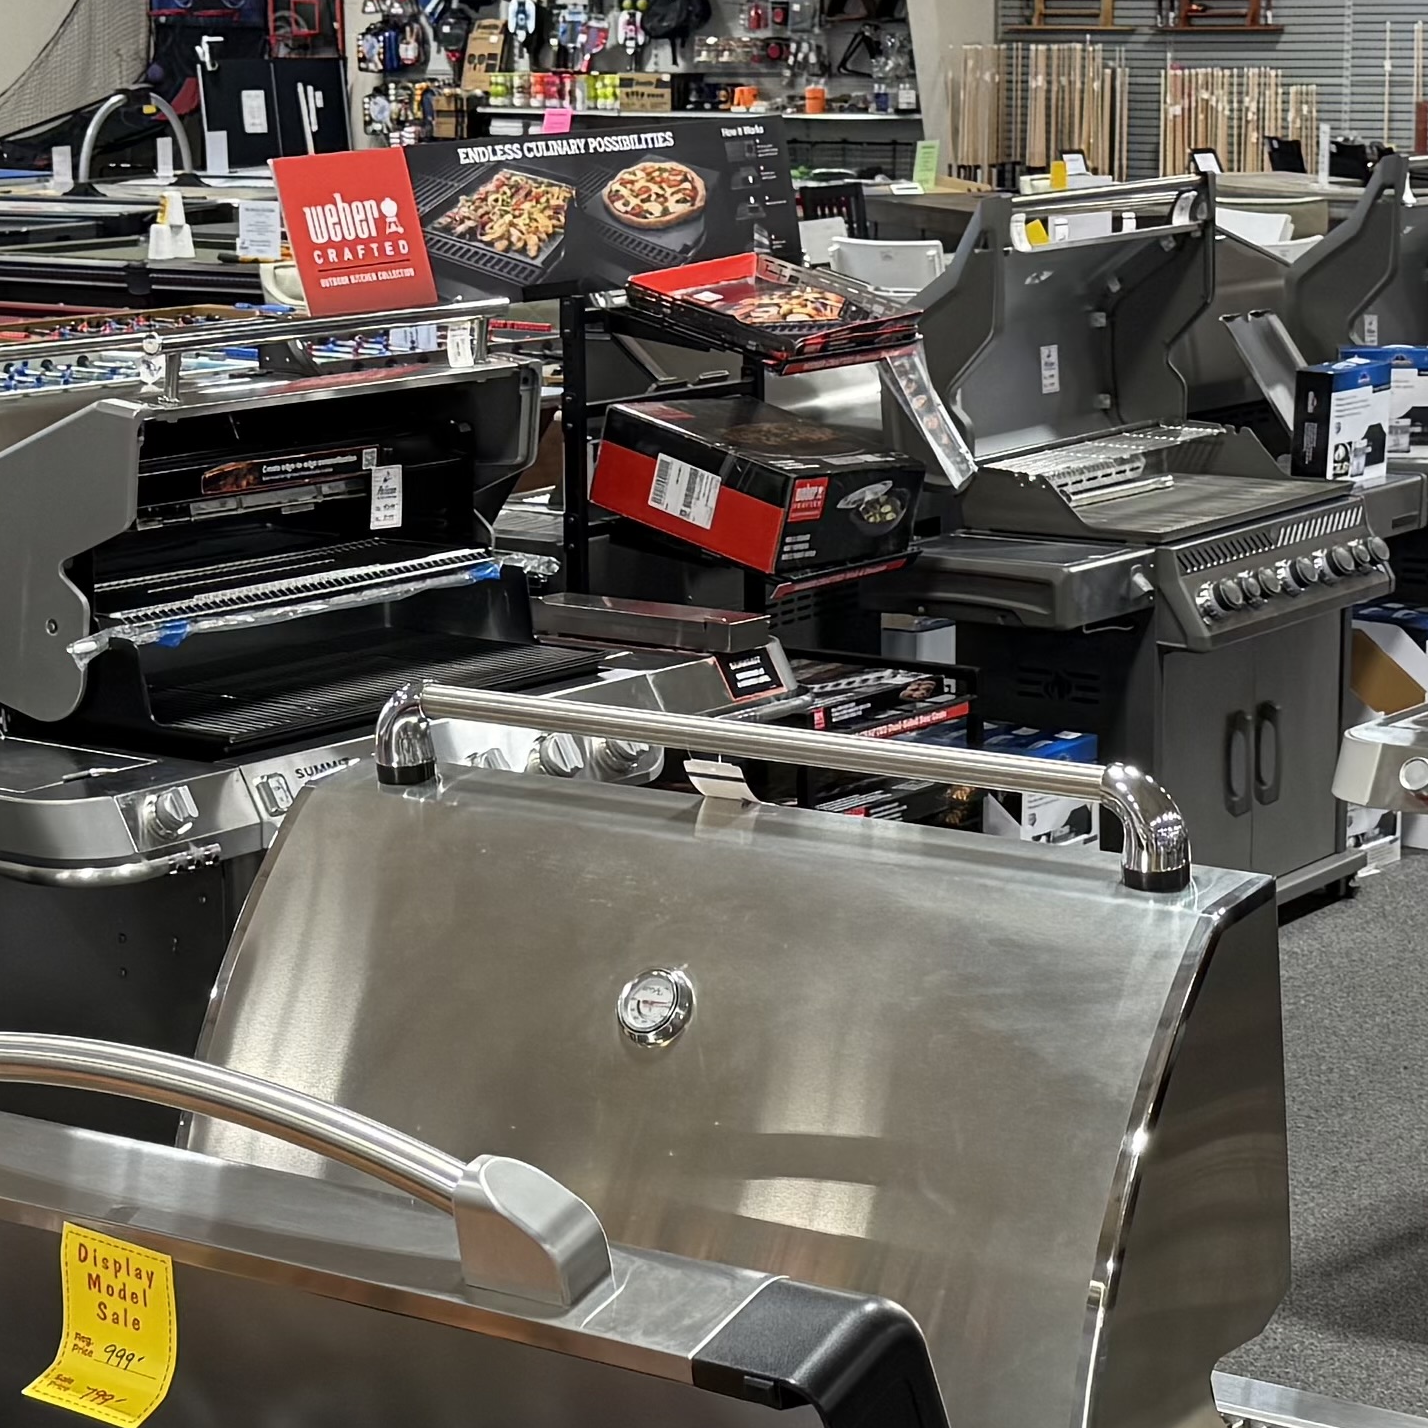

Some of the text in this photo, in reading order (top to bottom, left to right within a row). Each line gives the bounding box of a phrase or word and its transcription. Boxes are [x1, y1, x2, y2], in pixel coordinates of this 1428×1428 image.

[457, 130, 675, 165] ENDLESS CULINARY POSSIBILITIES
[302, 192, 379, 244] weber
[313, 239, 409, 264] CRAFTED
[77, 1242, 155, 1290] Display
[87, 1272, 149, 1307] Model
[96, 1301, 142, 1332] Sale
[72, 1344, 94, 1359] Price
